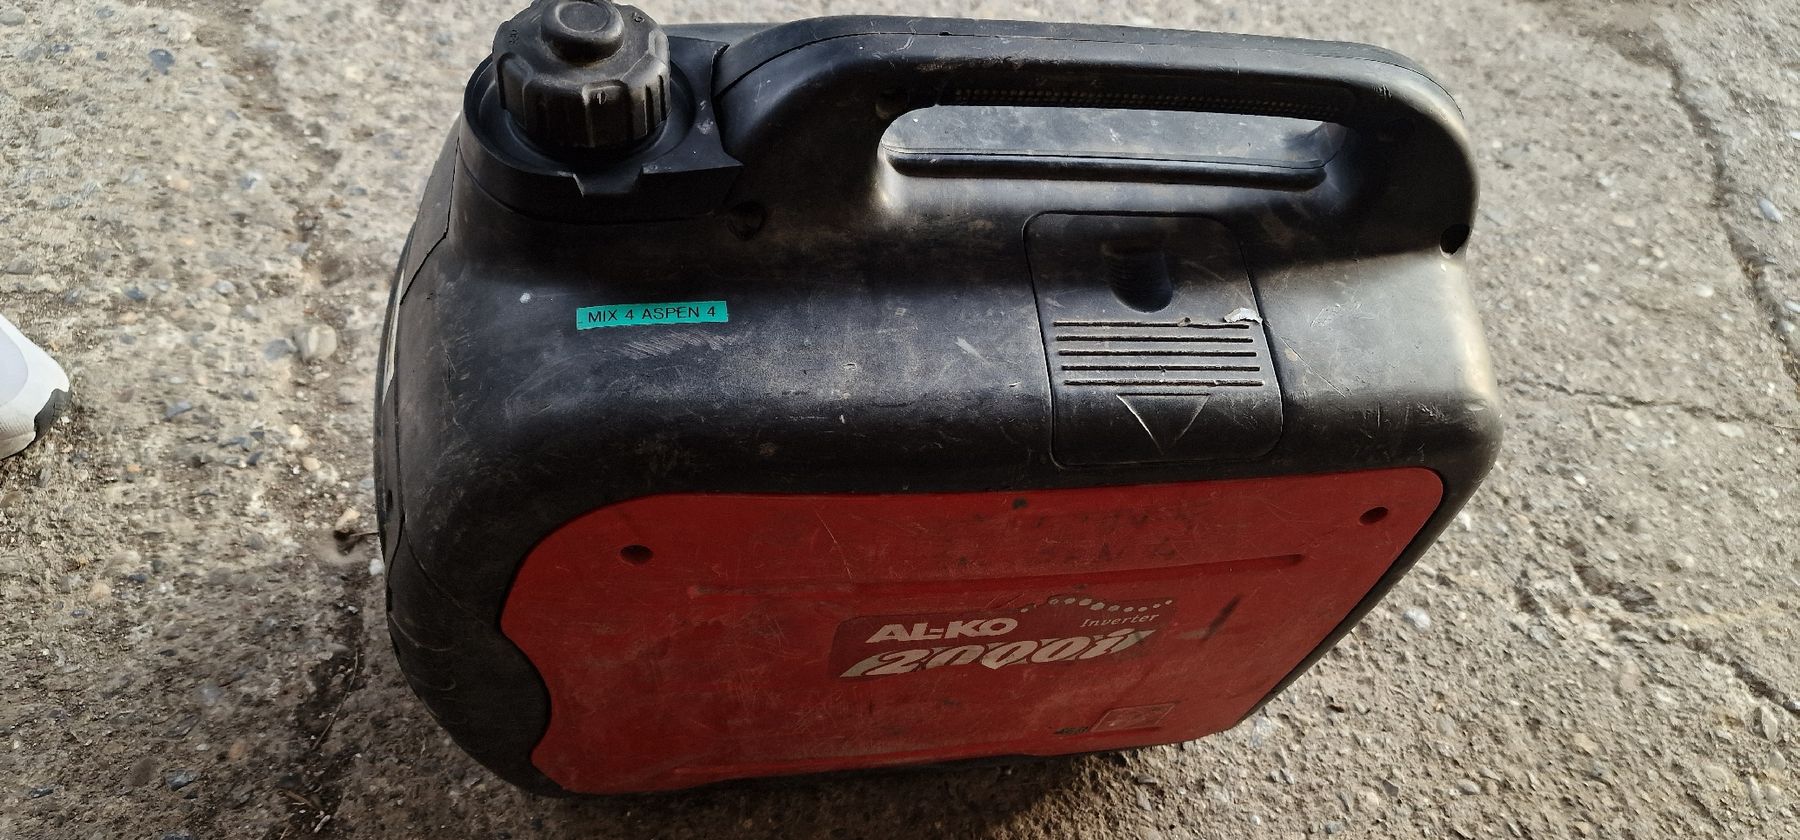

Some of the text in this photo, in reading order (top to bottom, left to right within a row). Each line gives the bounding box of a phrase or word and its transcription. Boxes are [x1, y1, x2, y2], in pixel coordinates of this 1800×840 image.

[588, 305, 716, 323] MIX 4 ASPEN 4
[865, 617, 1018, 643] AL-KO
[1079, 614, 1160, 628] Inverter
